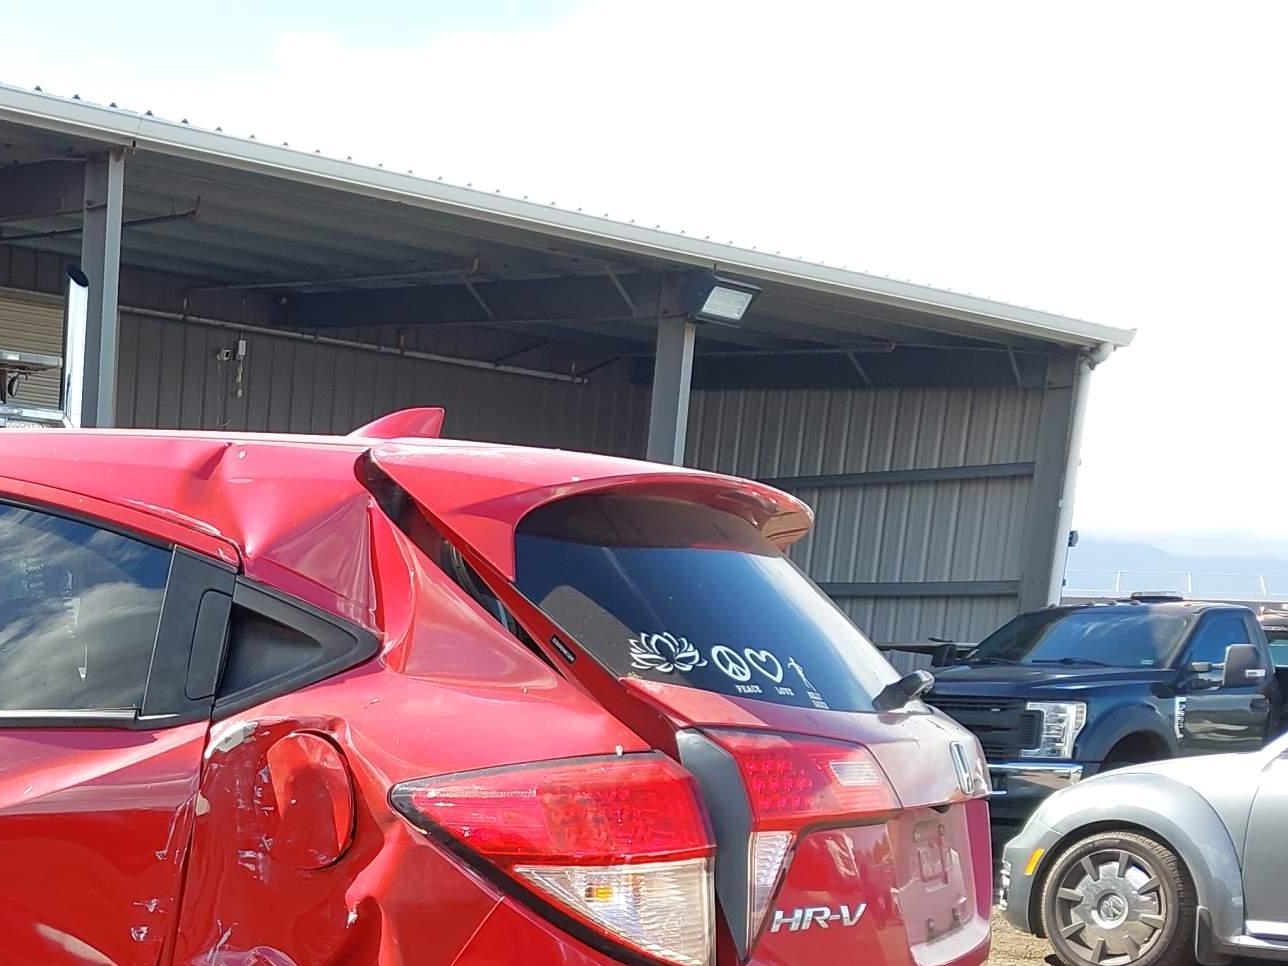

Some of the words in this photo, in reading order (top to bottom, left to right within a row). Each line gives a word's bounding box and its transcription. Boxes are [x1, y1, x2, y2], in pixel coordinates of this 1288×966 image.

[734, 684, 763, 694] PEACE
[774, 686, 796, 696] LOVE
[770, 903, 868, 933] HR-V
